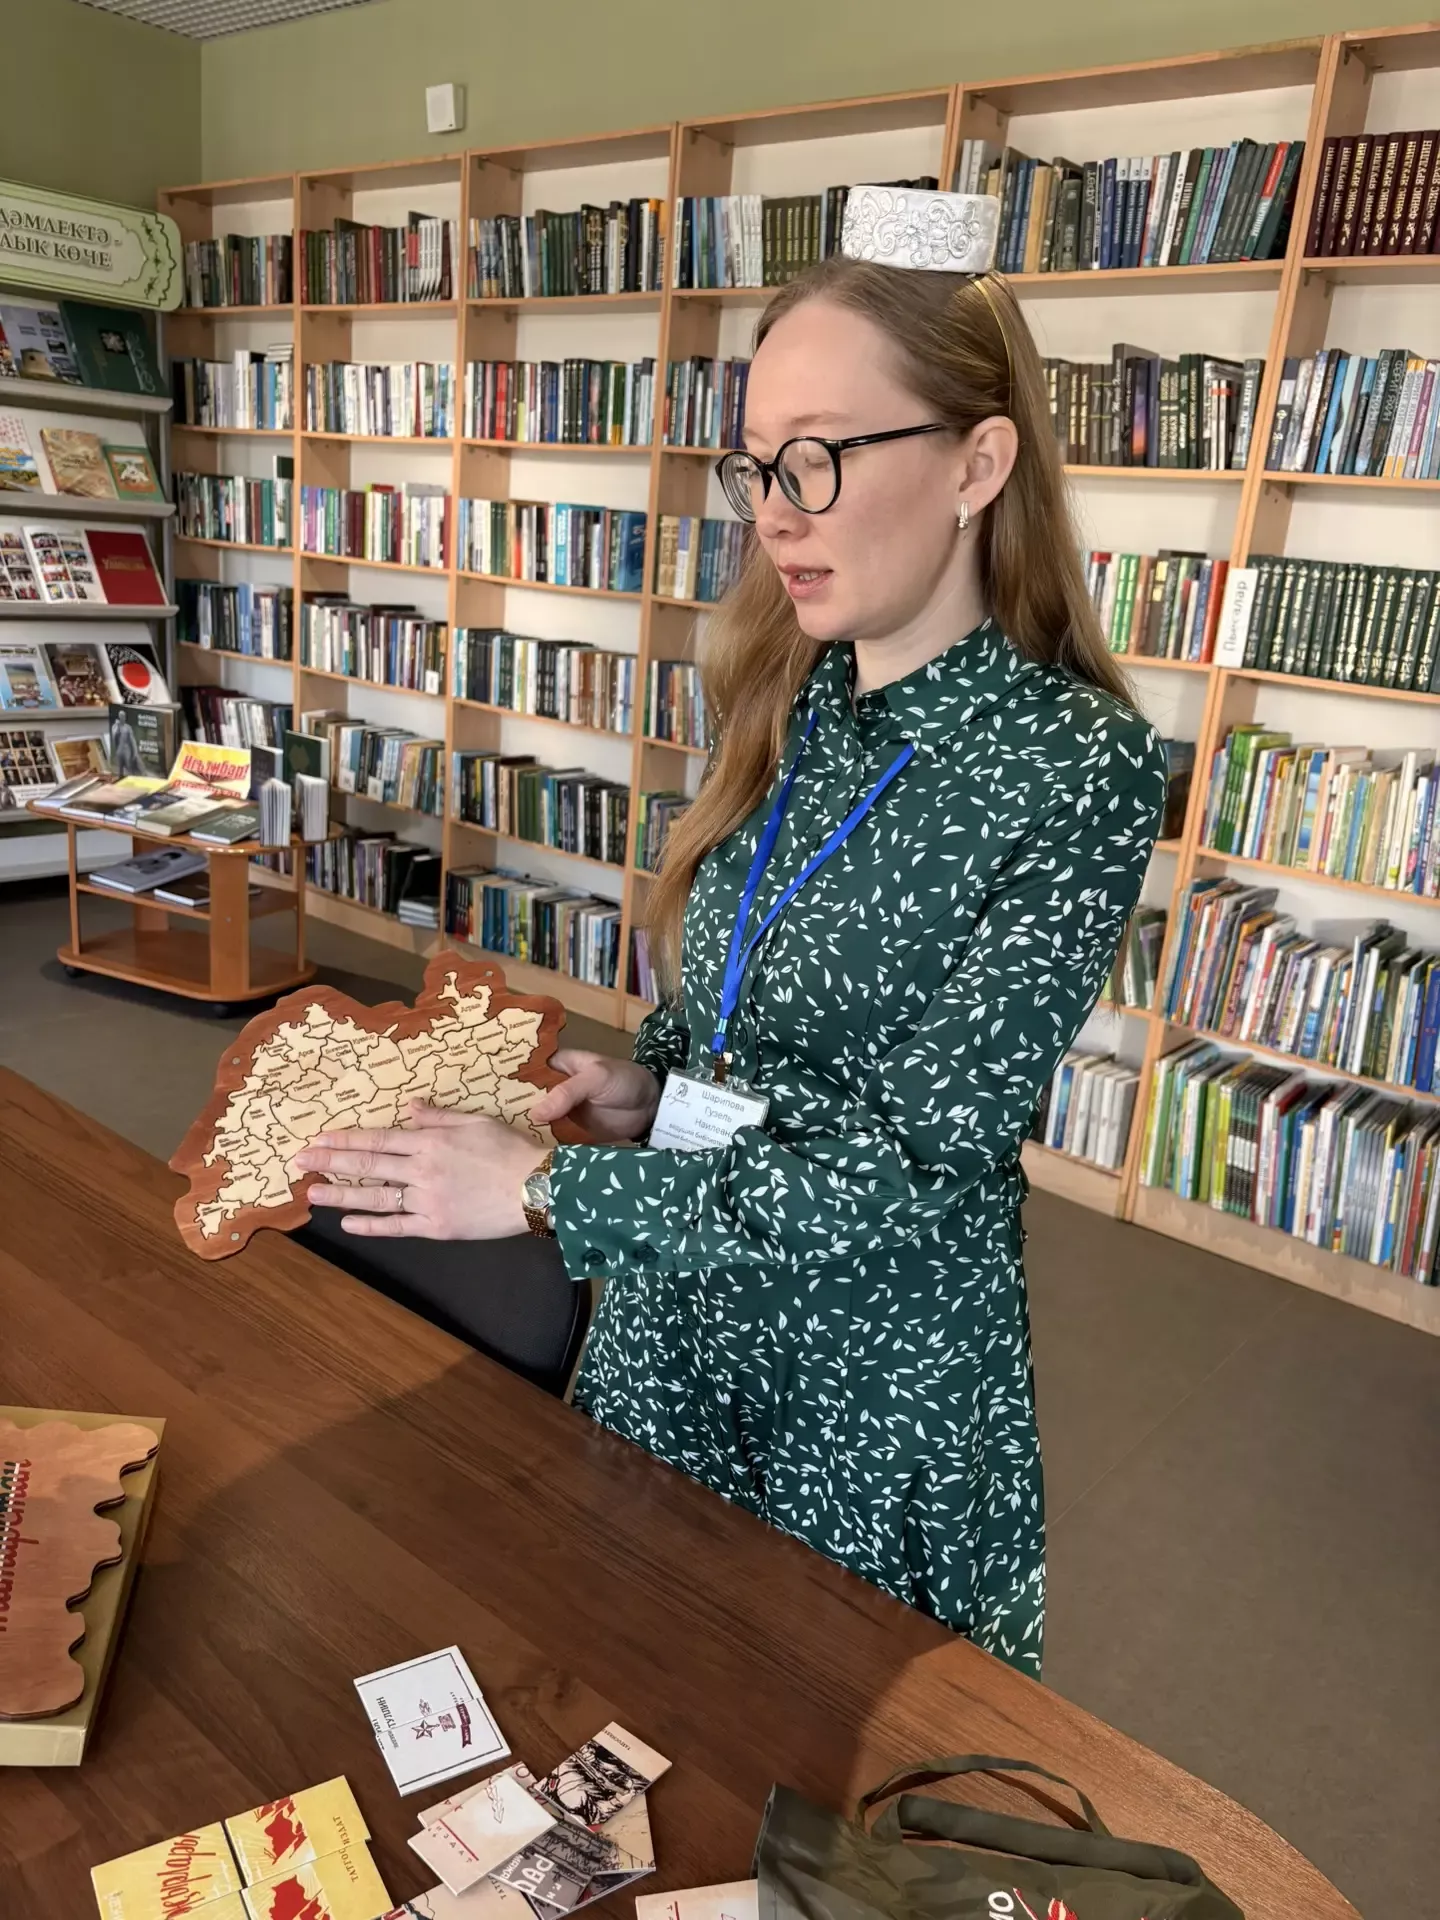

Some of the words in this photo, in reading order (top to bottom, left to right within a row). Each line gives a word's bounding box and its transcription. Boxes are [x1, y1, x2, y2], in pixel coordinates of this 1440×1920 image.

[1346, 189, 1358, 220] ФӘНИС
[1352, 142, 1367, 187] ЯРУЛЛИН
[1369, 146, 1383, 189] ЯРУЛЛИН
[1377, 188, 1388, 220] ФӘНИС
[1383, 142, 1398, 186] ЯРУЛЛИН
[1400, 141, 1416, 186] ЯРУЛЛИН
[1416, 140, 1432, 184] ЯРУЛЛИН
[1394, 188, 1407, 220] ФӘНИС
[1410, 187, 1424, 219] ФӘНИС
[54, 243, 110, 267] КӨЧЕ
[1222, 581, 1248, 652] Пьесалар
[702, 1090, 745, 1112] Шарипова
[704, 1106, 733, 1123] Гузель
